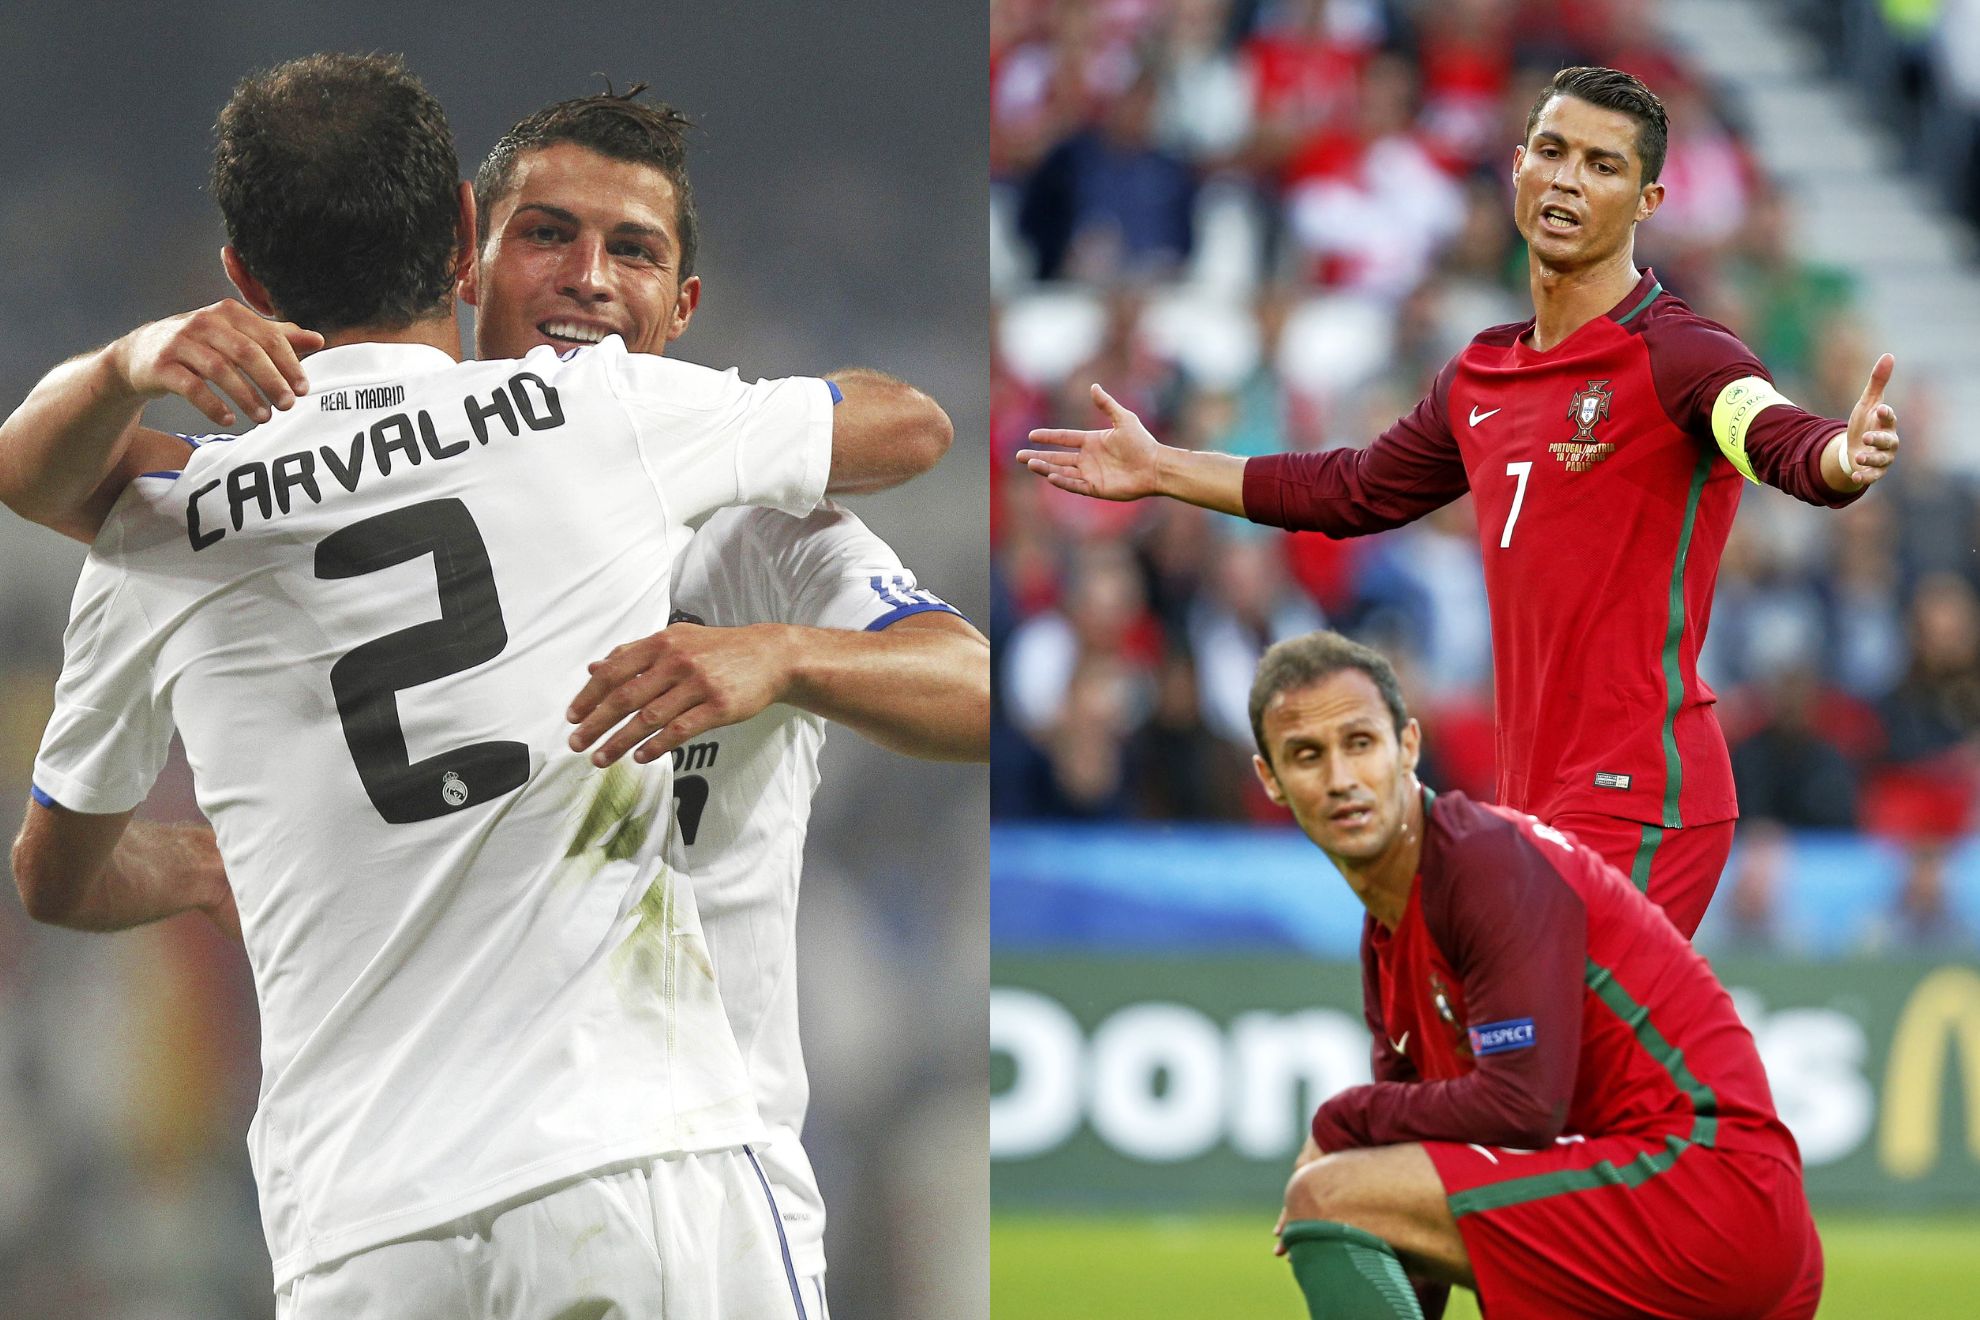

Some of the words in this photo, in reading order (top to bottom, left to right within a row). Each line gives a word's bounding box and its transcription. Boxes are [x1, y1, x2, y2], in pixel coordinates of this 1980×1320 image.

[321, 391, 351, 411] REAL
[355, 385, 405, 410] MADRID
[187, 372, 565, 552] CARVALHO
[1565, 461, 1592, 472] PARIS
[1500, 461, 1532, 548] 7
[314, 497, 531, 825] 2
[673, 741, 719, 772] om
[1480, 1025, 1534, 1047] RESPECT
